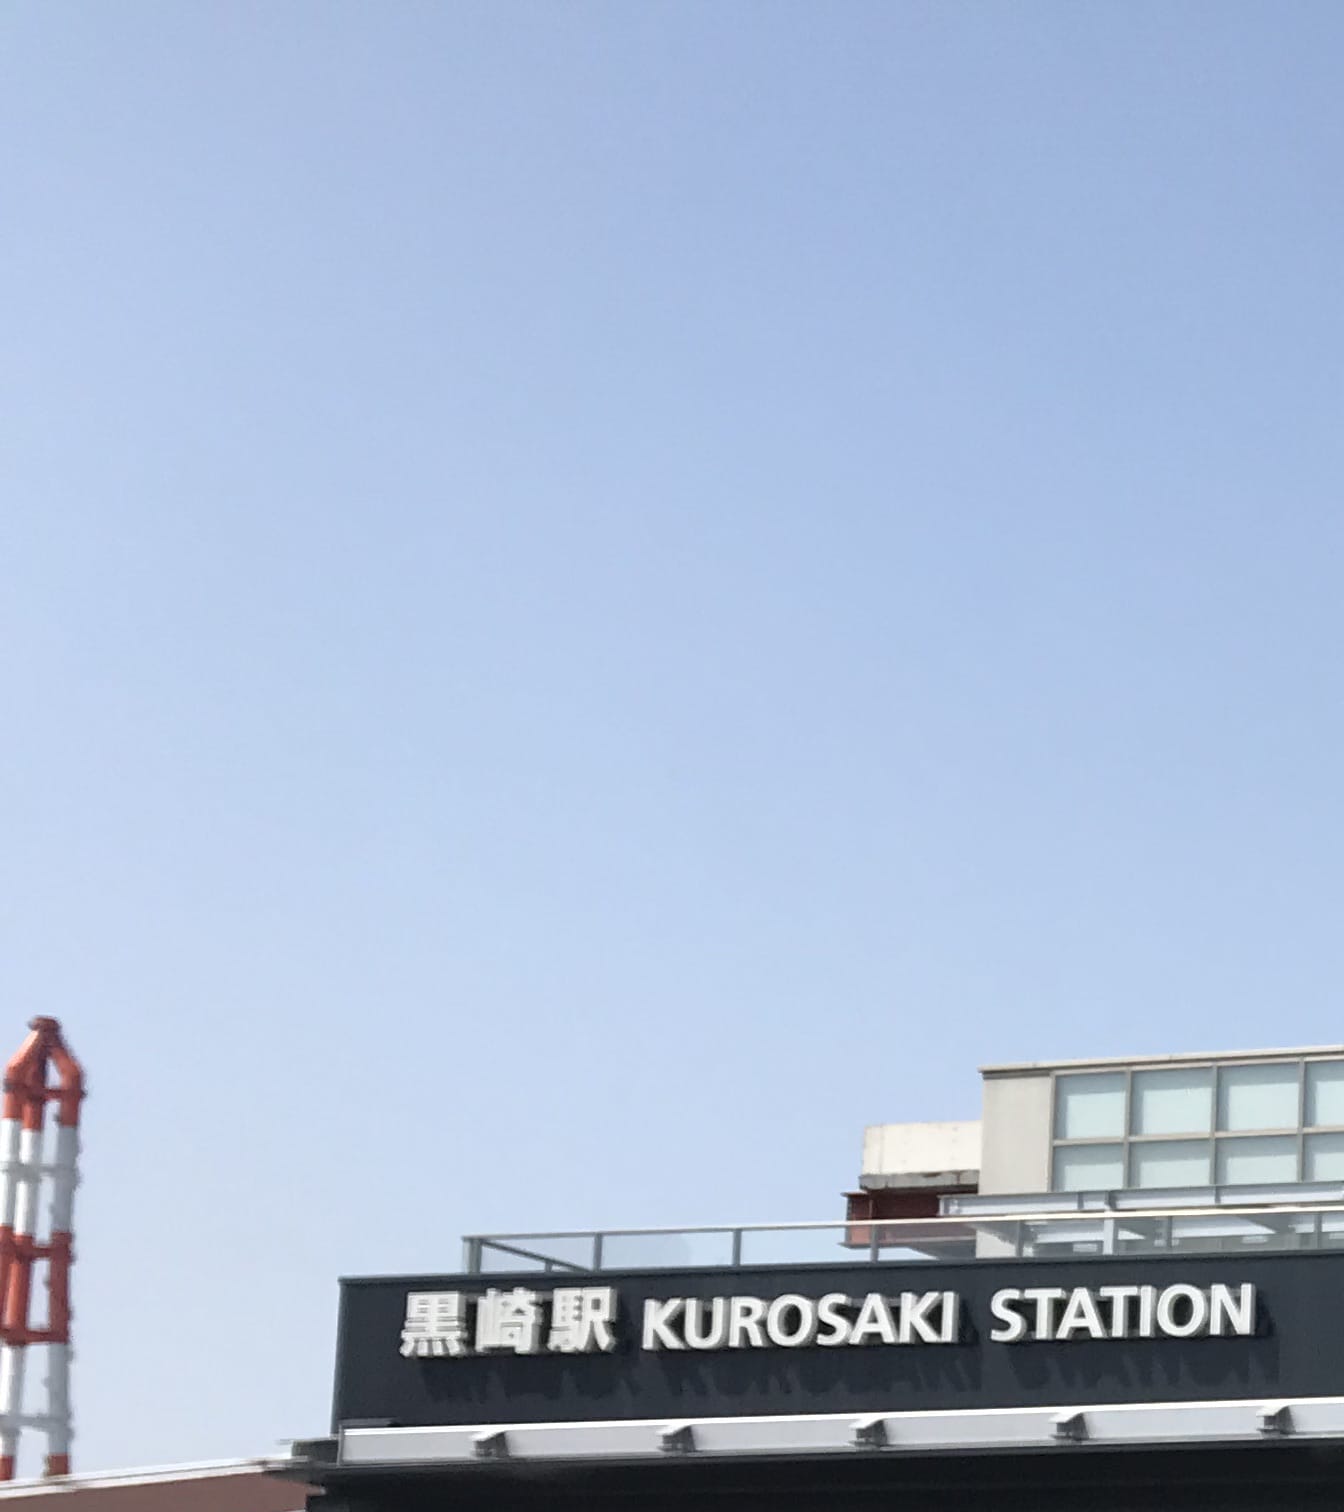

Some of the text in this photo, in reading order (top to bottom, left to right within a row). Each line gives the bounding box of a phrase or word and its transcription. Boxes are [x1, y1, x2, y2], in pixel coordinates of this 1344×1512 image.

[401, 1283, 1255, 1357] 黒崎駅 KUROSAKI STATION
